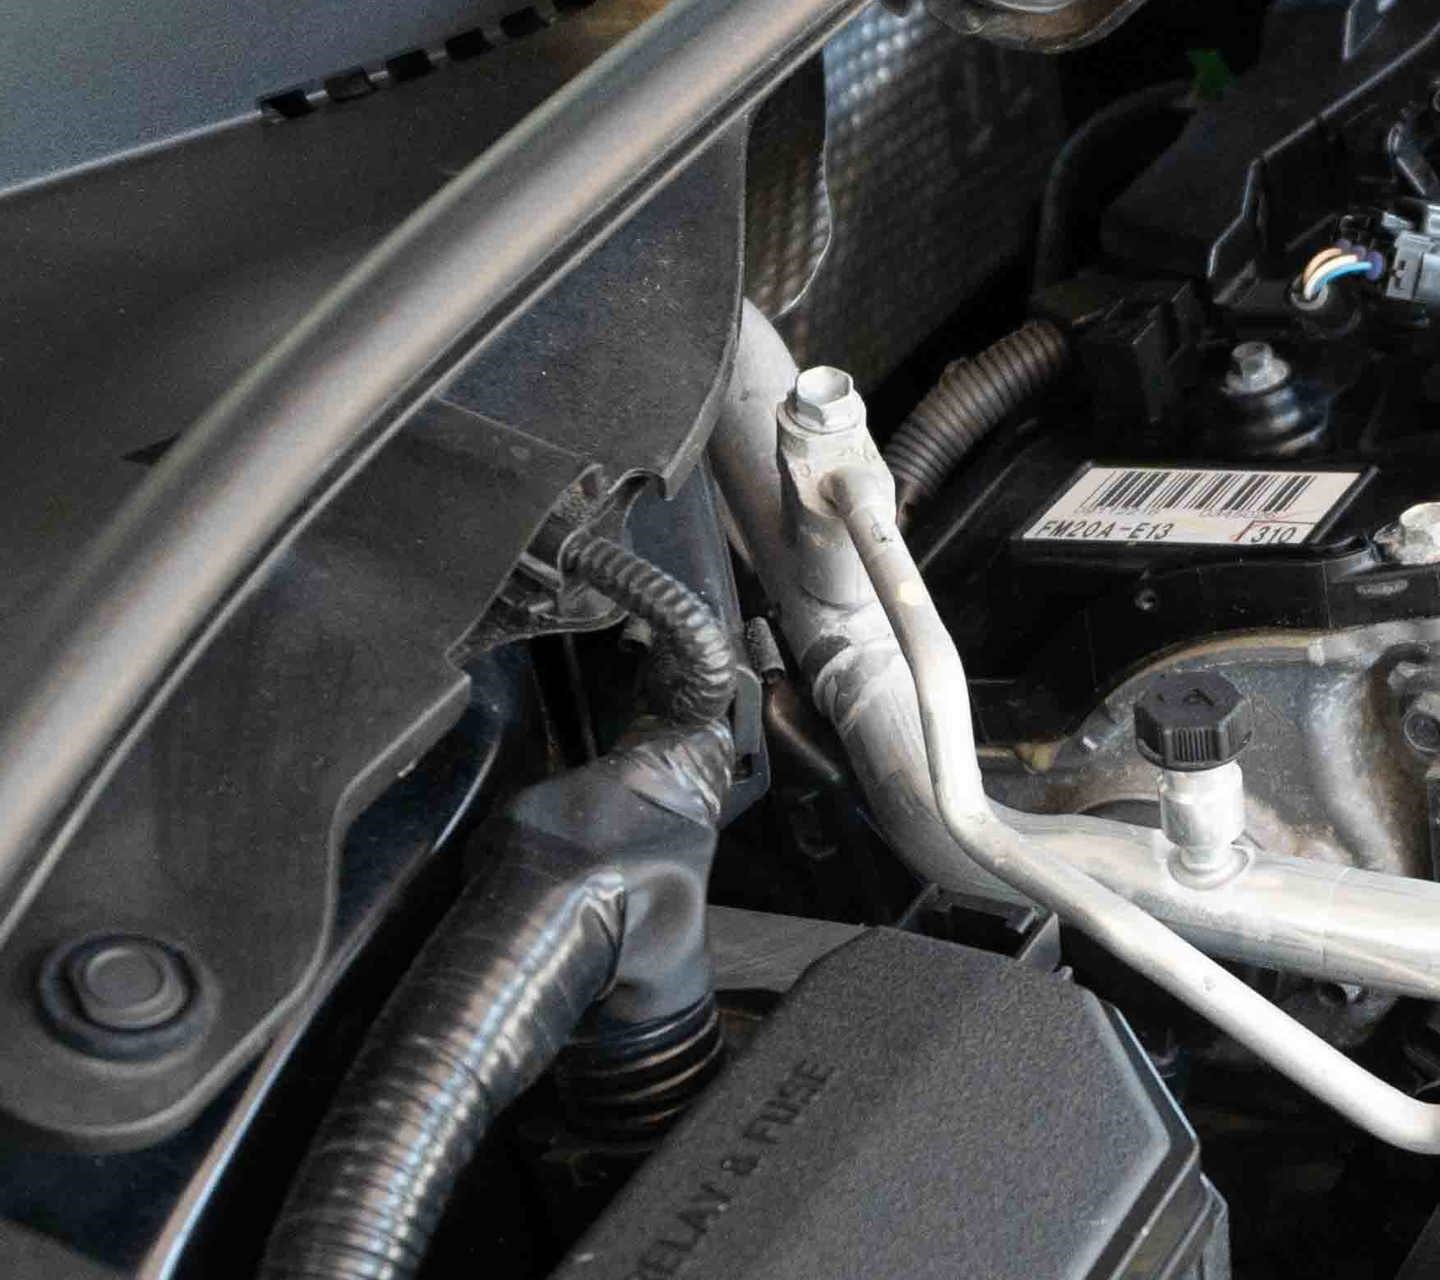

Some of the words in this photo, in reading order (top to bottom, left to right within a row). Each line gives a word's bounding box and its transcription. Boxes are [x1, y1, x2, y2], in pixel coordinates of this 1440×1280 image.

[1034, 520, 1175, 540] FM20A-E13
[1250, 526, 1297, 543] 310
[742, 1059, 834, 1146] FUSE
